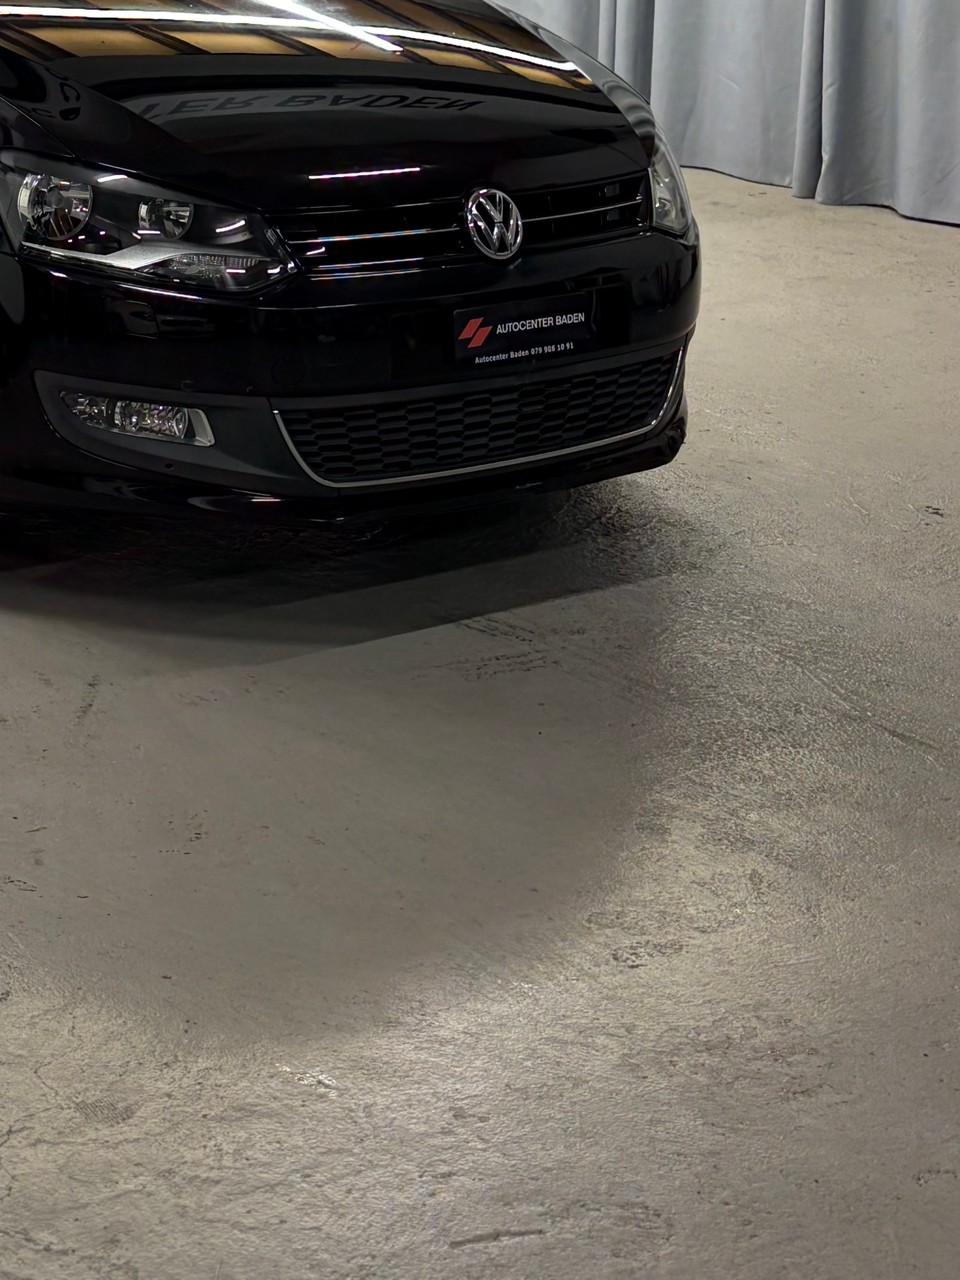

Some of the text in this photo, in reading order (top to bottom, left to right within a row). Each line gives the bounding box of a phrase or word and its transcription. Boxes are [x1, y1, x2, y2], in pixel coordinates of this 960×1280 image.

[496, 312, 585, 334] AUTOCENTER BADEN
[474, 353, 509, 364] Autocenter
[510, 349, 529, 359] Baden
[530, 346, 543, 355] 079
[557, 343, 565, 352] 10
[565, 341, 574, 350] 91
